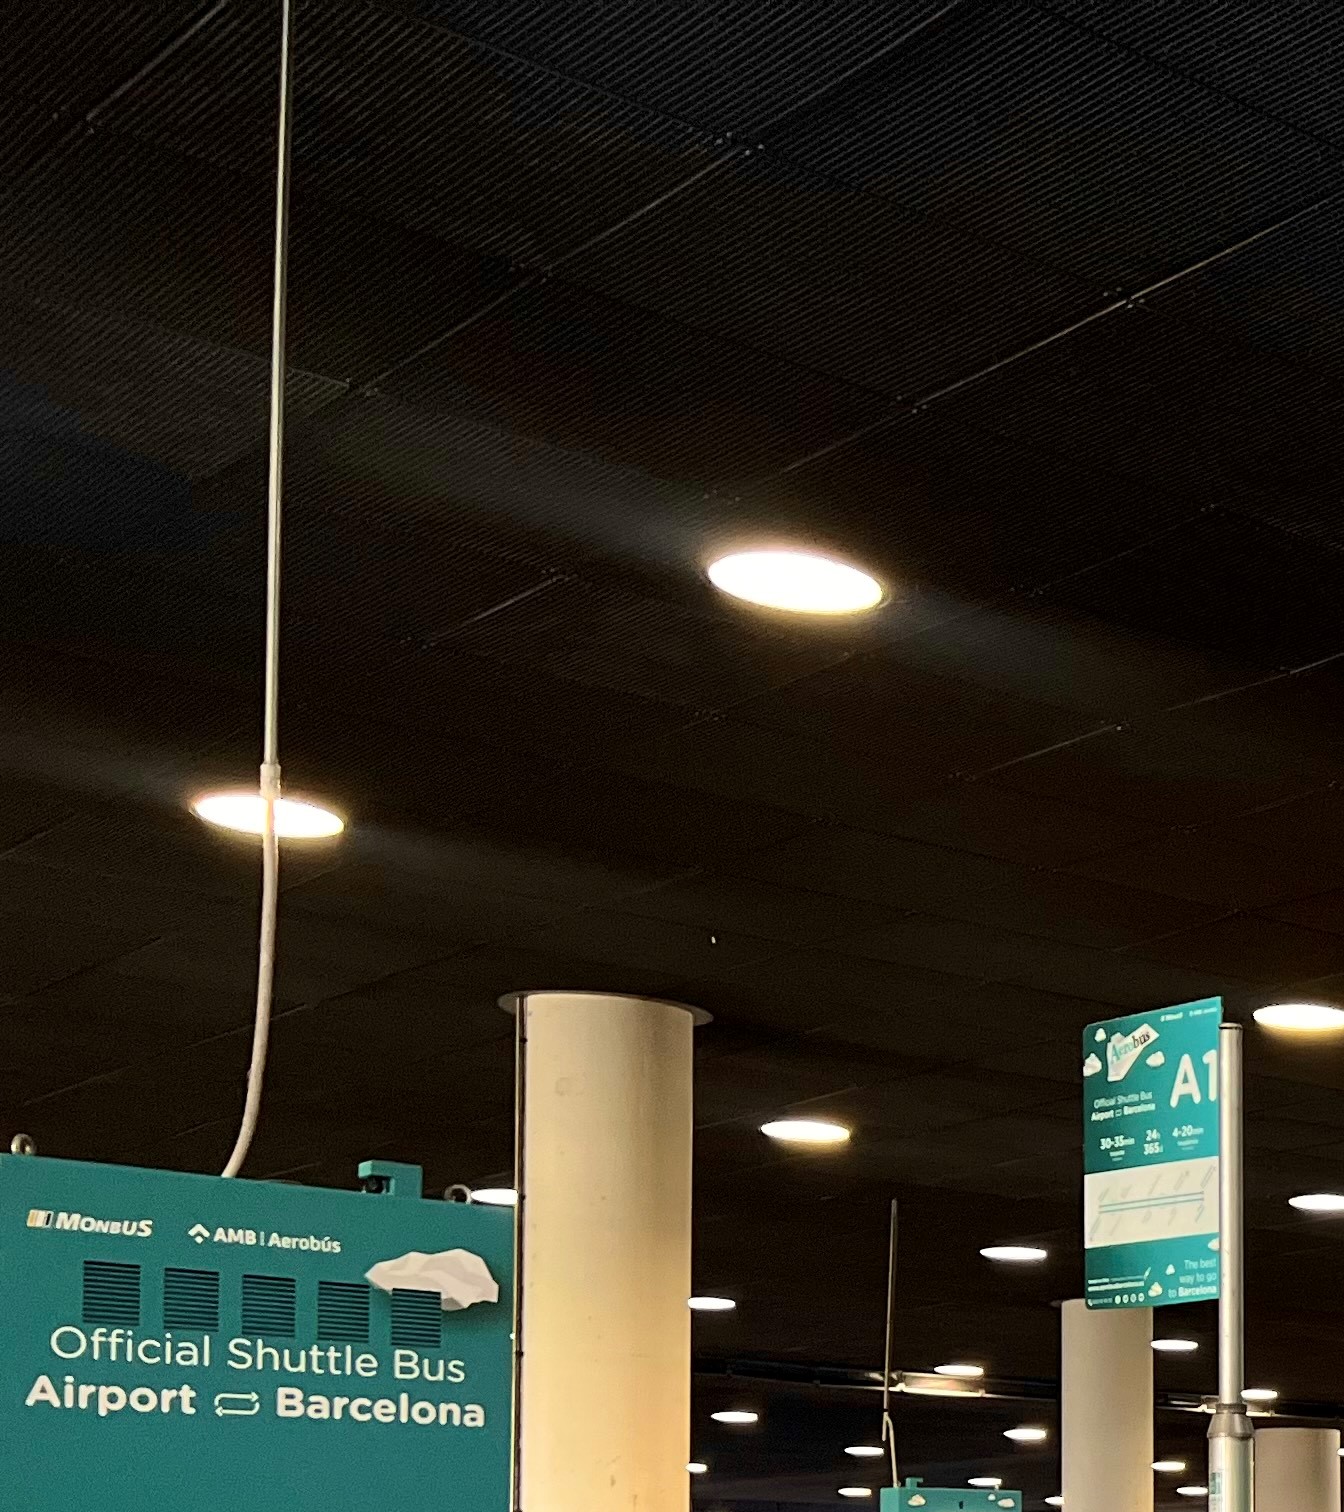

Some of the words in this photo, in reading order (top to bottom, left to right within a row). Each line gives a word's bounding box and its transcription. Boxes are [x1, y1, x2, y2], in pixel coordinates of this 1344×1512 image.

[1169, 1049, 1218, 1109] A1
[1091, 1109, 1115, 1122] Airport
[213, 1227, 257, 1246] AMB
[268, 1232, 342, 1254] Aerobús
[50, 1325, 210, 1368] Official
[227, 1336, 379, 1377] Shuttle
[393, 1349, 467, 1383] Bus
[24, 1375, 197, 1417] Airport
[275, 1387, 486, 1429] Barcelona
